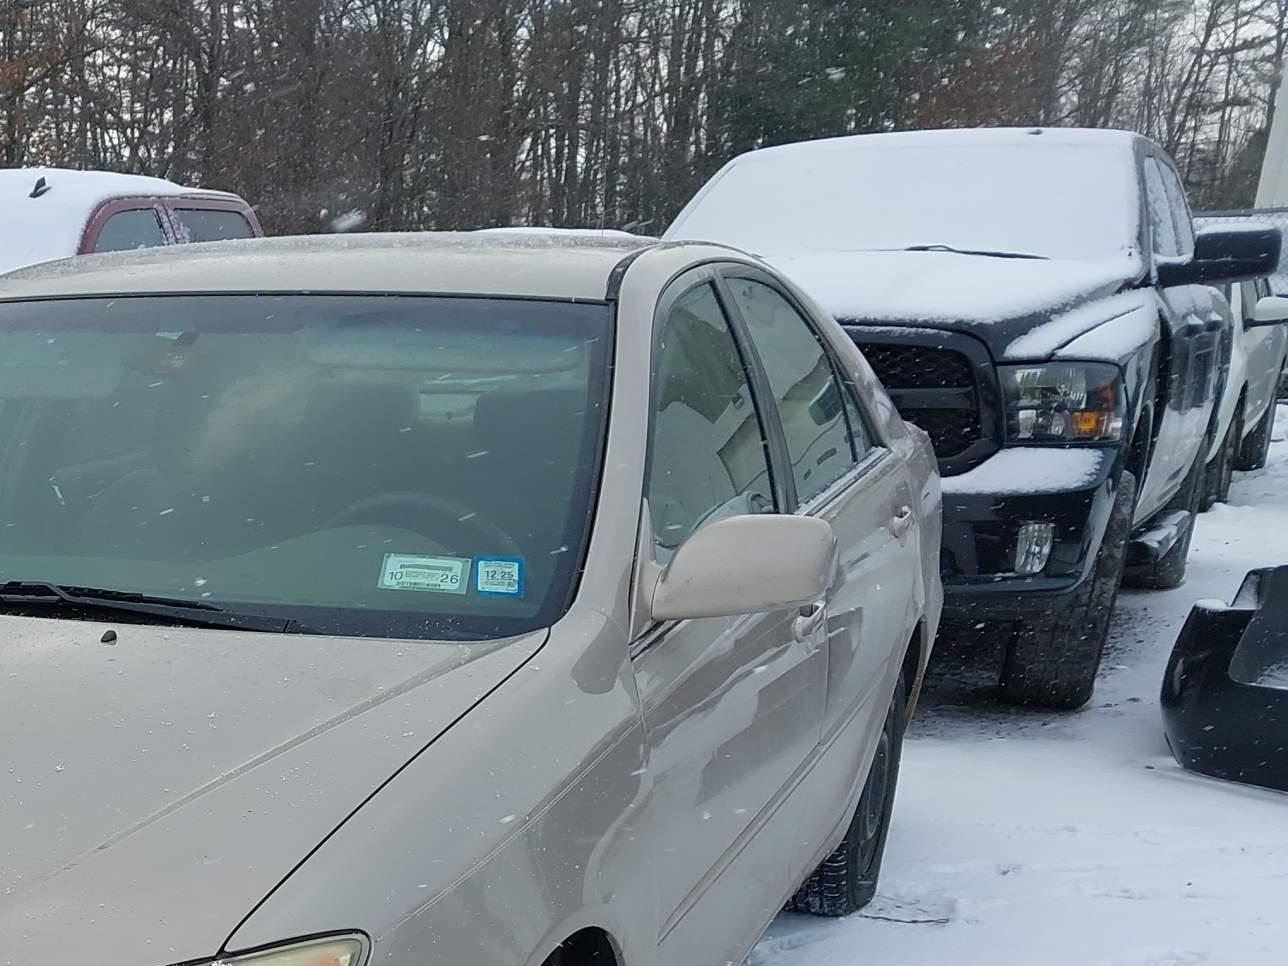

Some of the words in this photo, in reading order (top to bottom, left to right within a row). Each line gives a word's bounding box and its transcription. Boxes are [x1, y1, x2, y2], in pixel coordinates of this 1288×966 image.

[388, 571, 404, 581] 10
[439, 573, 459, 584] 26
[486, 570, 497, 579] 12
[500, 571, 514, 579] 25
